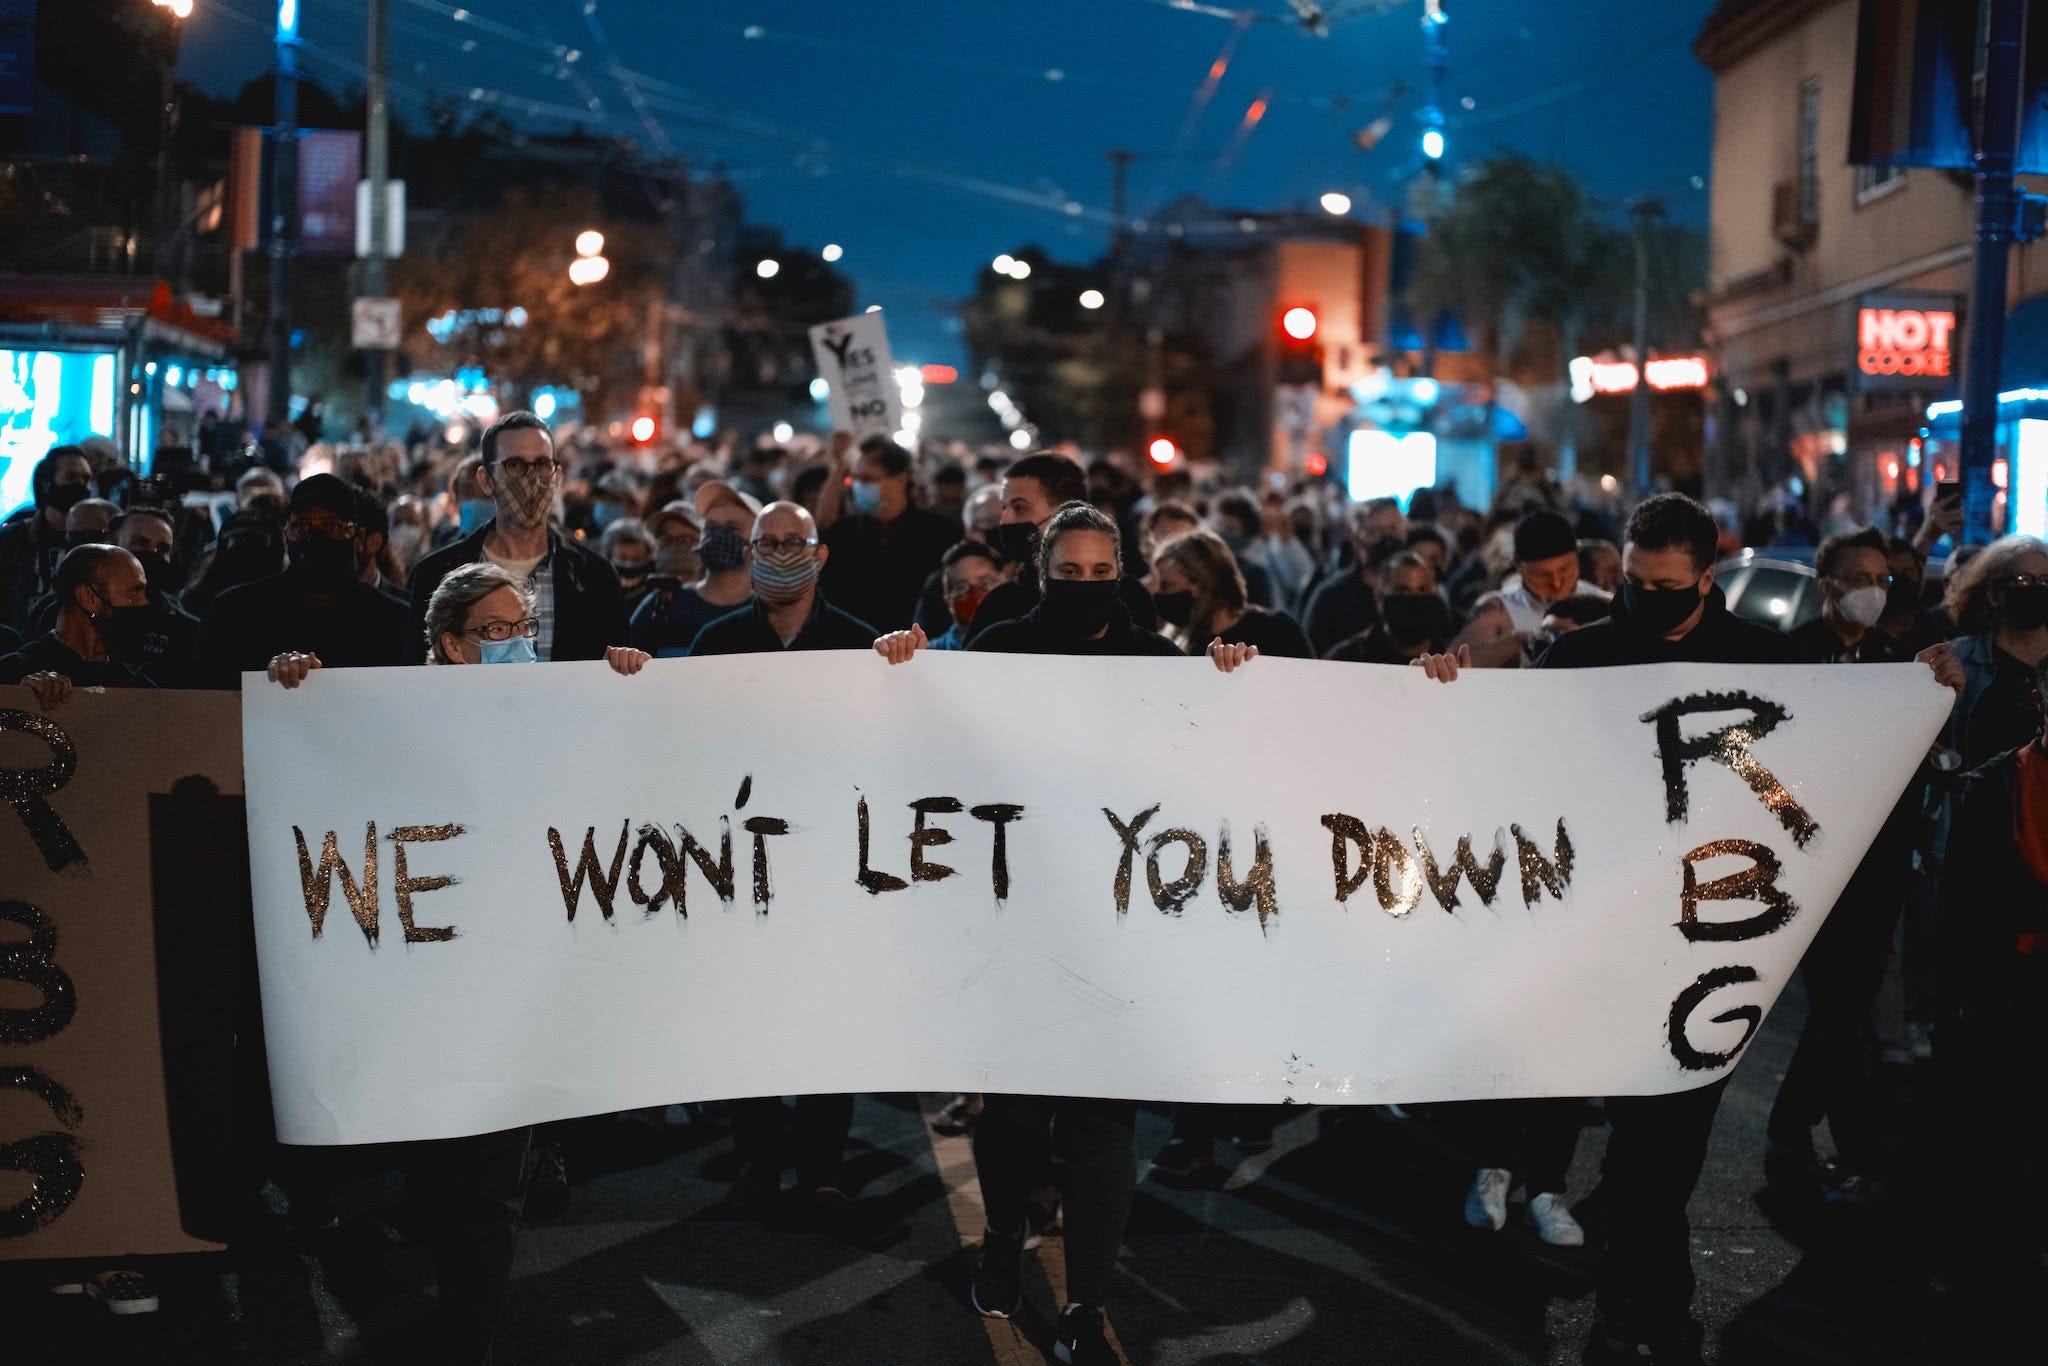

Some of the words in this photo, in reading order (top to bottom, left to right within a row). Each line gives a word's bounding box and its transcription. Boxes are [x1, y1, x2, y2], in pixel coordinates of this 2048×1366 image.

[1858, 308, 1956, 351] HOT
[822, 333, 875, 369] YES
[849, 399, 887, 418] NO
[292, 821, 467, 949] WE
[547, 773, 795, 926] WON'T
[855, 795, 1026, 905] LET
[1101, 802, 1279, 938] YOU
[1320, 812, 1576, 916] DOWN
